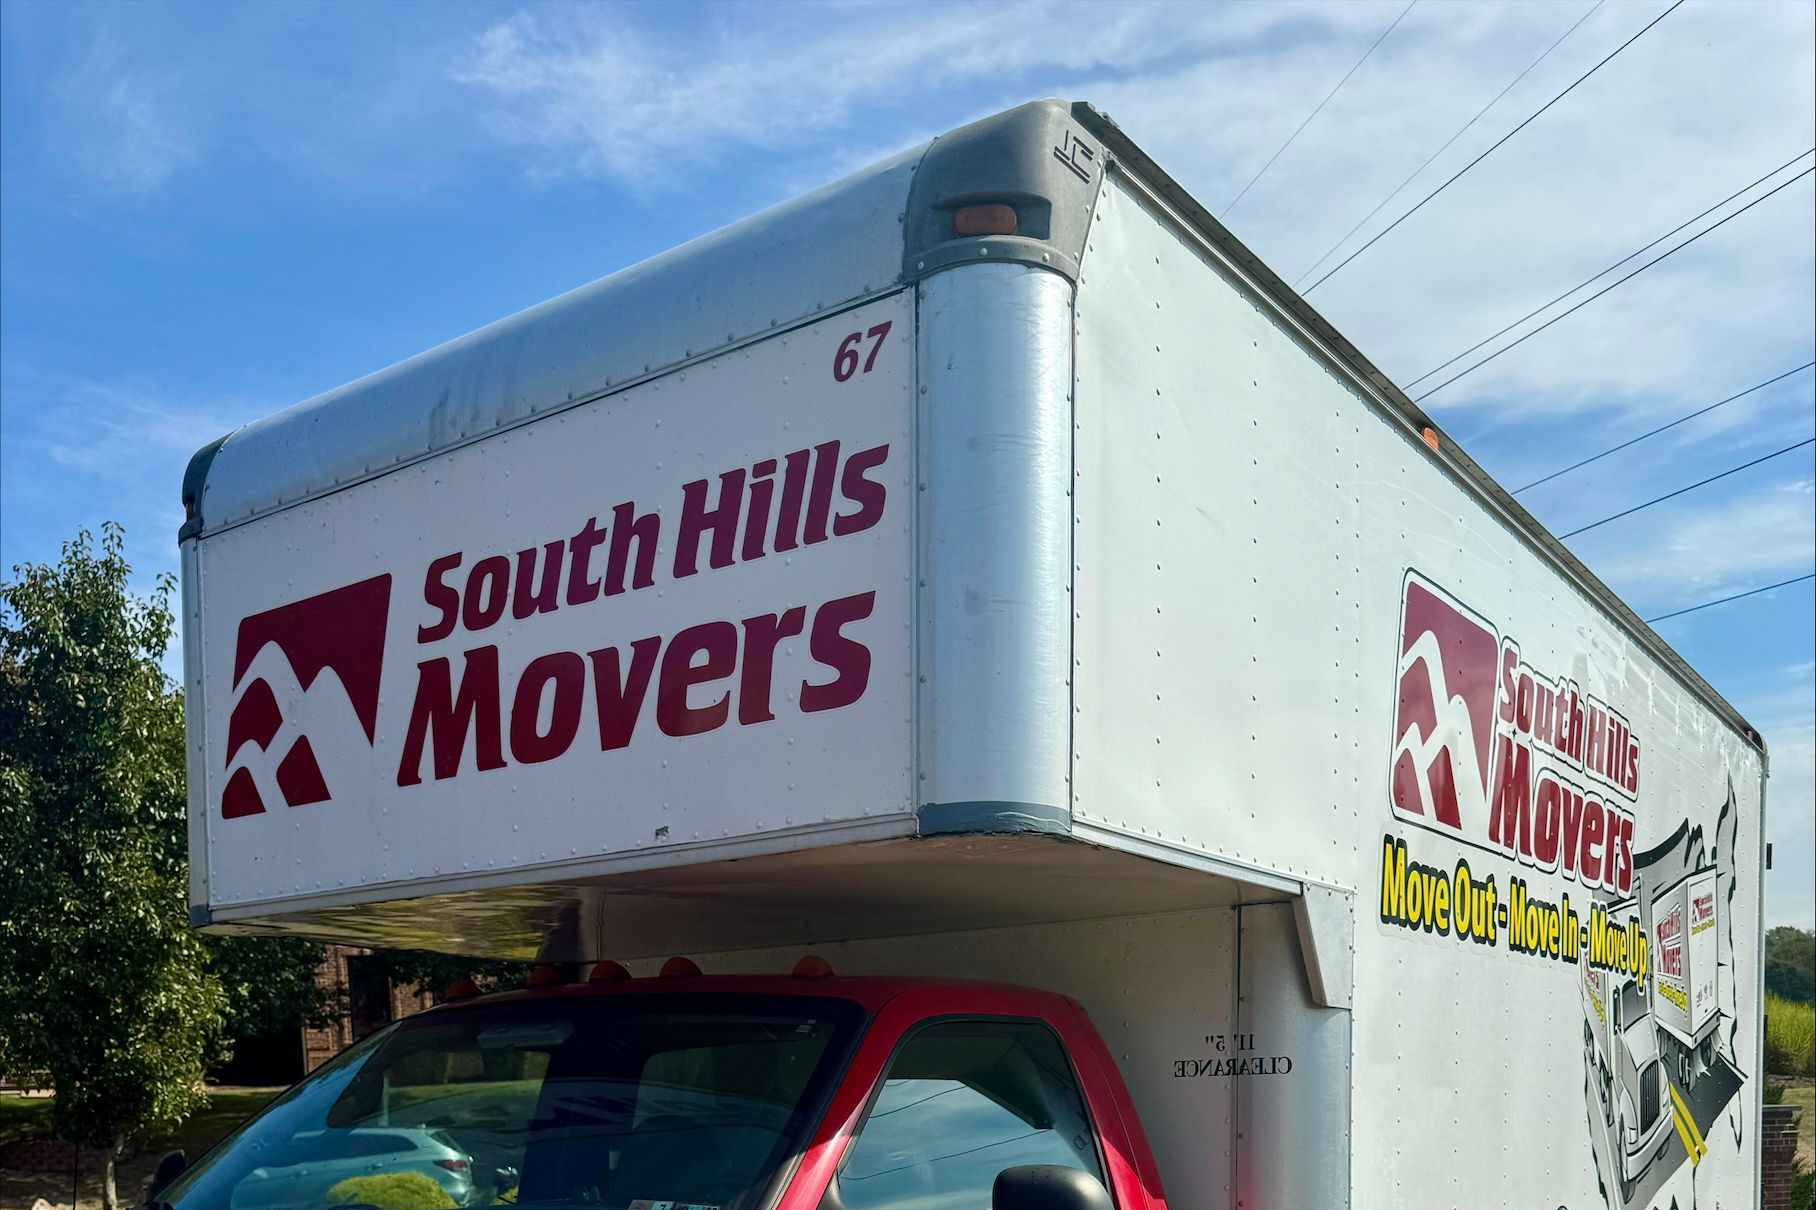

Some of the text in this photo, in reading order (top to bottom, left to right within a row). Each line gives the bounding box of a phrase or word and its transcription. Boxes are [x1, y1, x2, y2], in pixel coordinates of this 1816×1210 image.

[833, 321, 892, 383] 67
[417, 439, 890, 644] South Hills
[397, 590, 876, 787] Movers
[1501, 645, 1640, 795] South Hills
[1488, 734, 1635, 893] Movers
[1382, 839, 1451, 932] Move
[1455, 863, 1497, 940] Out
[1509, 881, 1559, 957] Move
[1562, 898, 1578, 960] In
[1590, 908, 1628, 973] Move
[1629, 919, 1649, 990] Up
